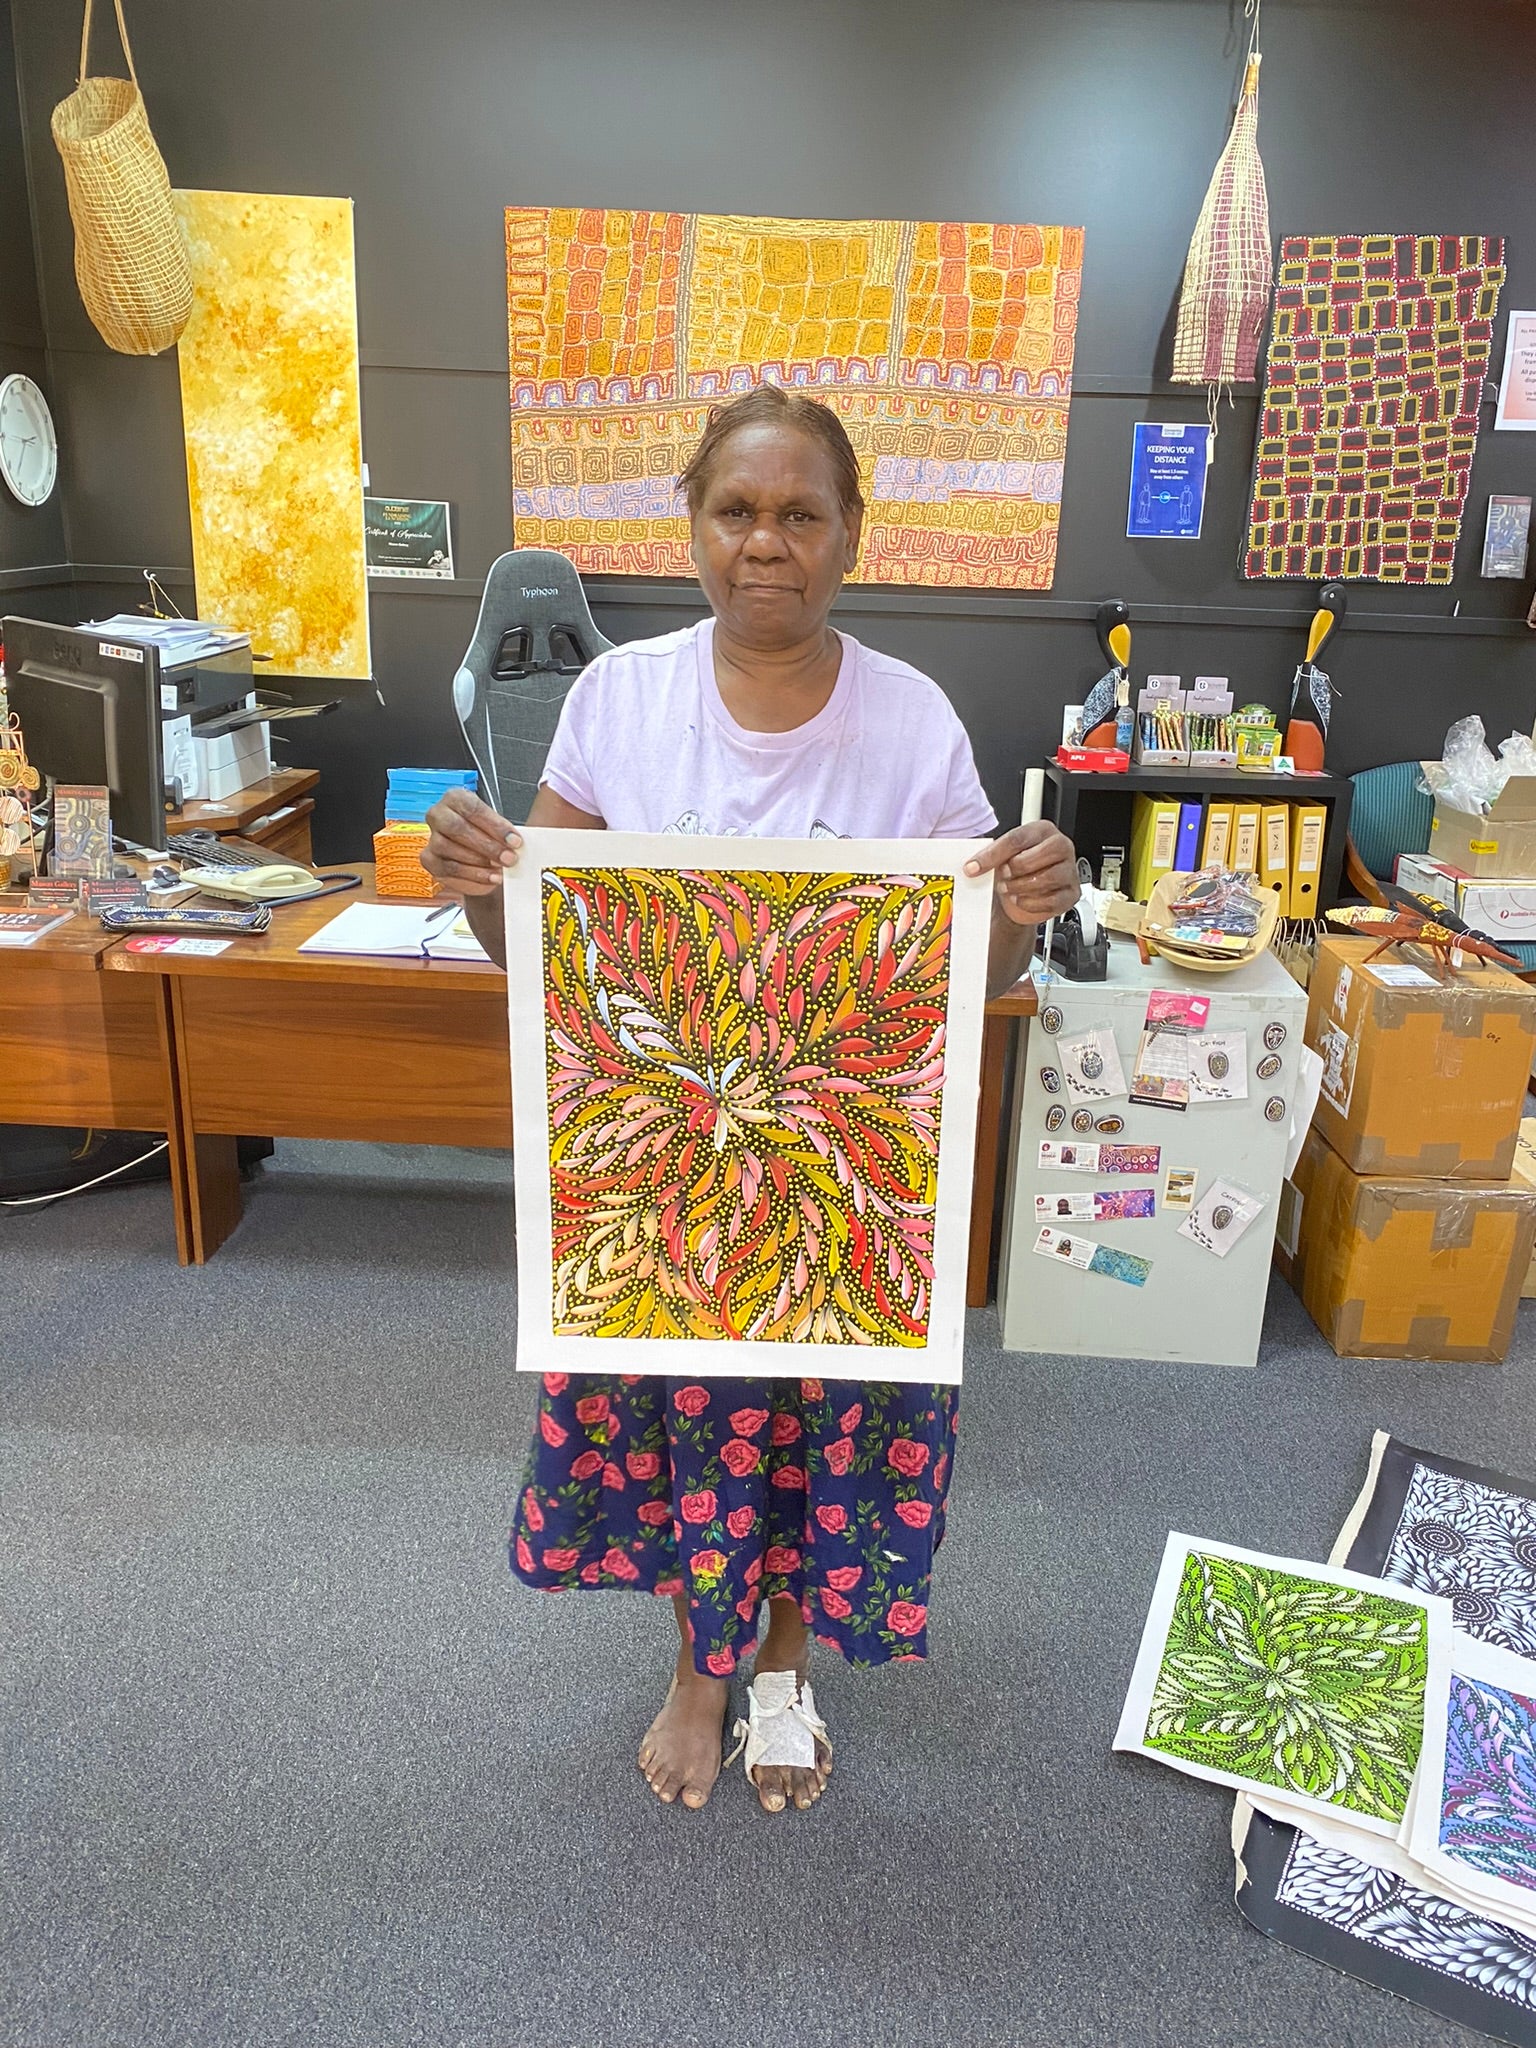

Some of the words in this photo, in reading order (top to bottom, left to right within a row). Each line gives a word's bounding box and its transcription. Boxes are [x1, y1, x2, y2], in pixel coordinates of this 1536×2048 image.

[1146, 445, 1175, 454] KEEPING
[1176, 446, 1195, 454] YOUR
[1154, 456, 1187, 464] DISTANCE
[520, 586, 559, 599] Typhoon
